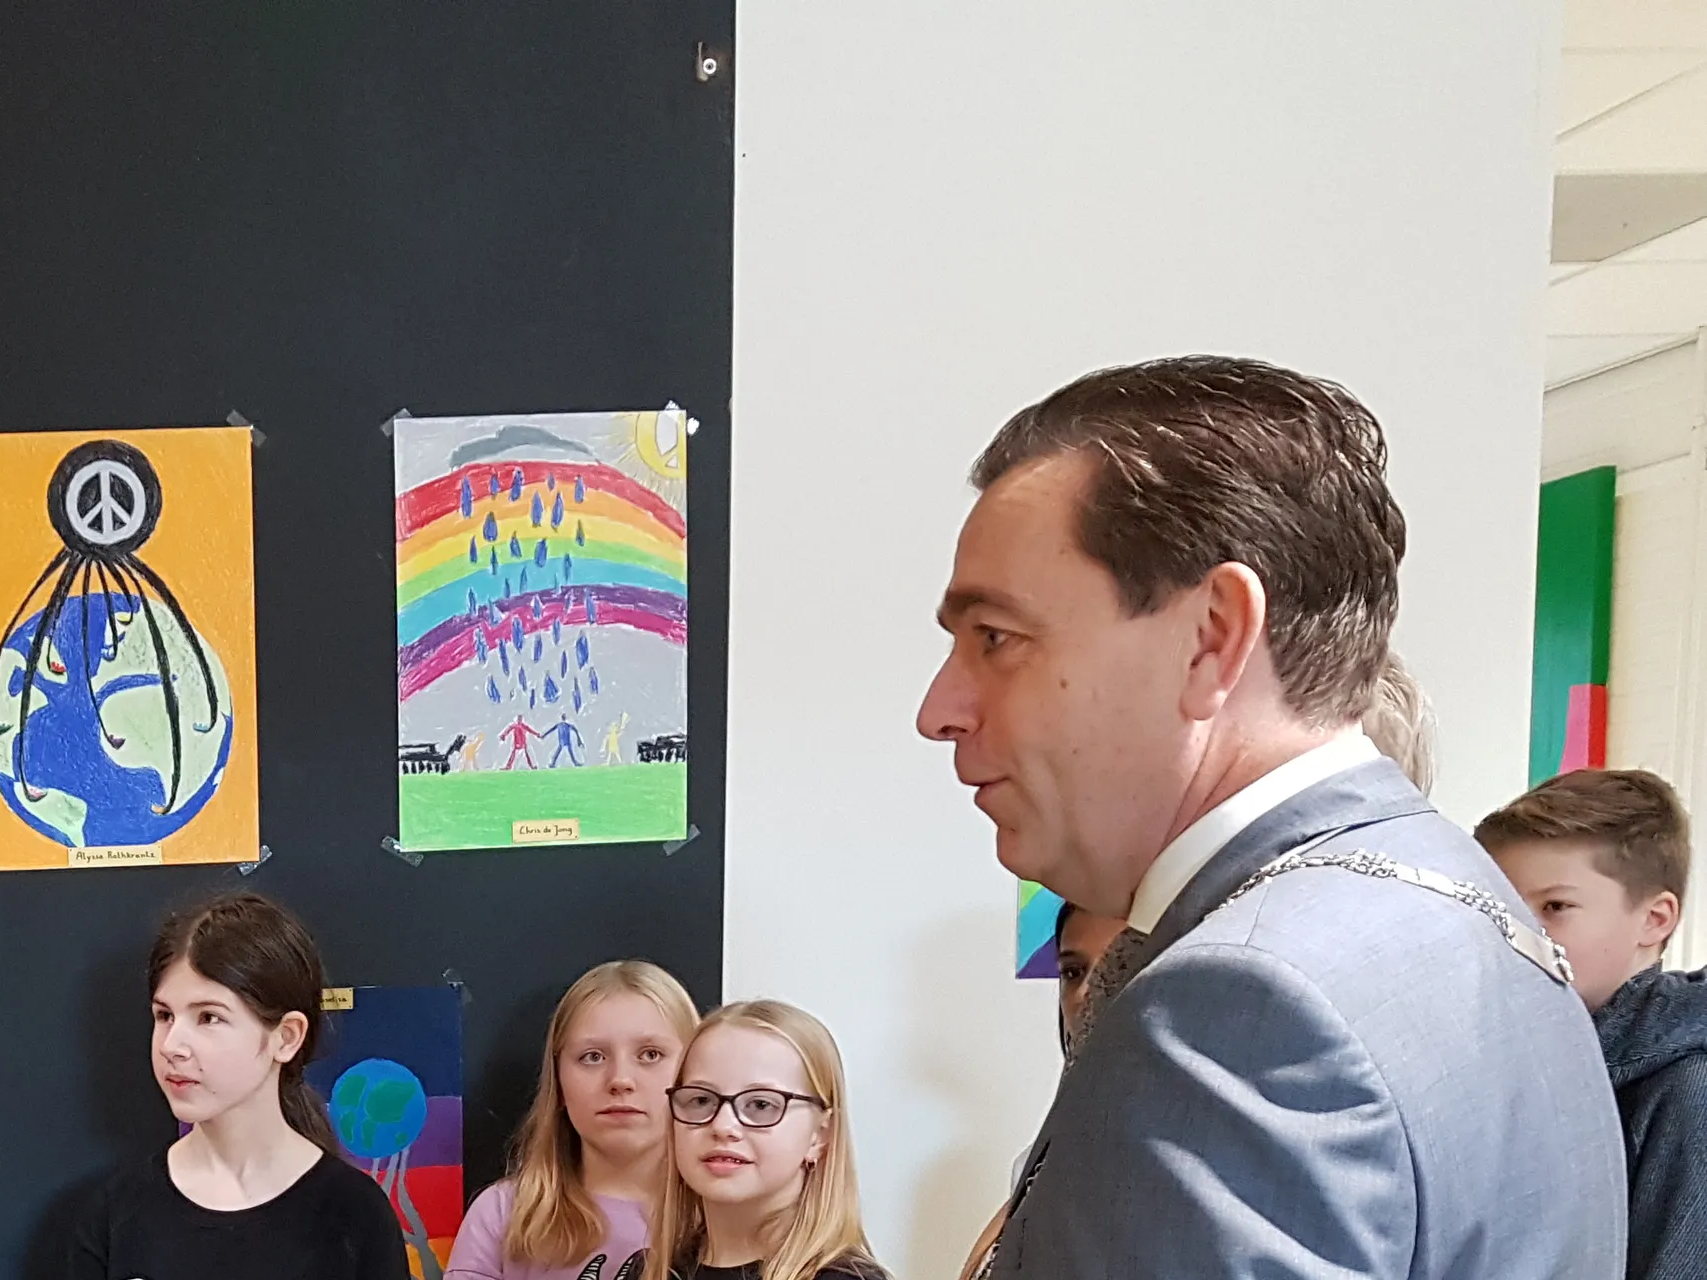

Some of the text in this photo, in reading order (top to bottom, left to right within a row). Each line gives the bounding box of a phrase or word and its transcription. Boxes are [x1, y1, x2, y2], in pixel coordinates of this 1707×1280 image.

[519, 824, 573, 837] Chris de Jong
[75, 850, 104, 864] Alyssa
